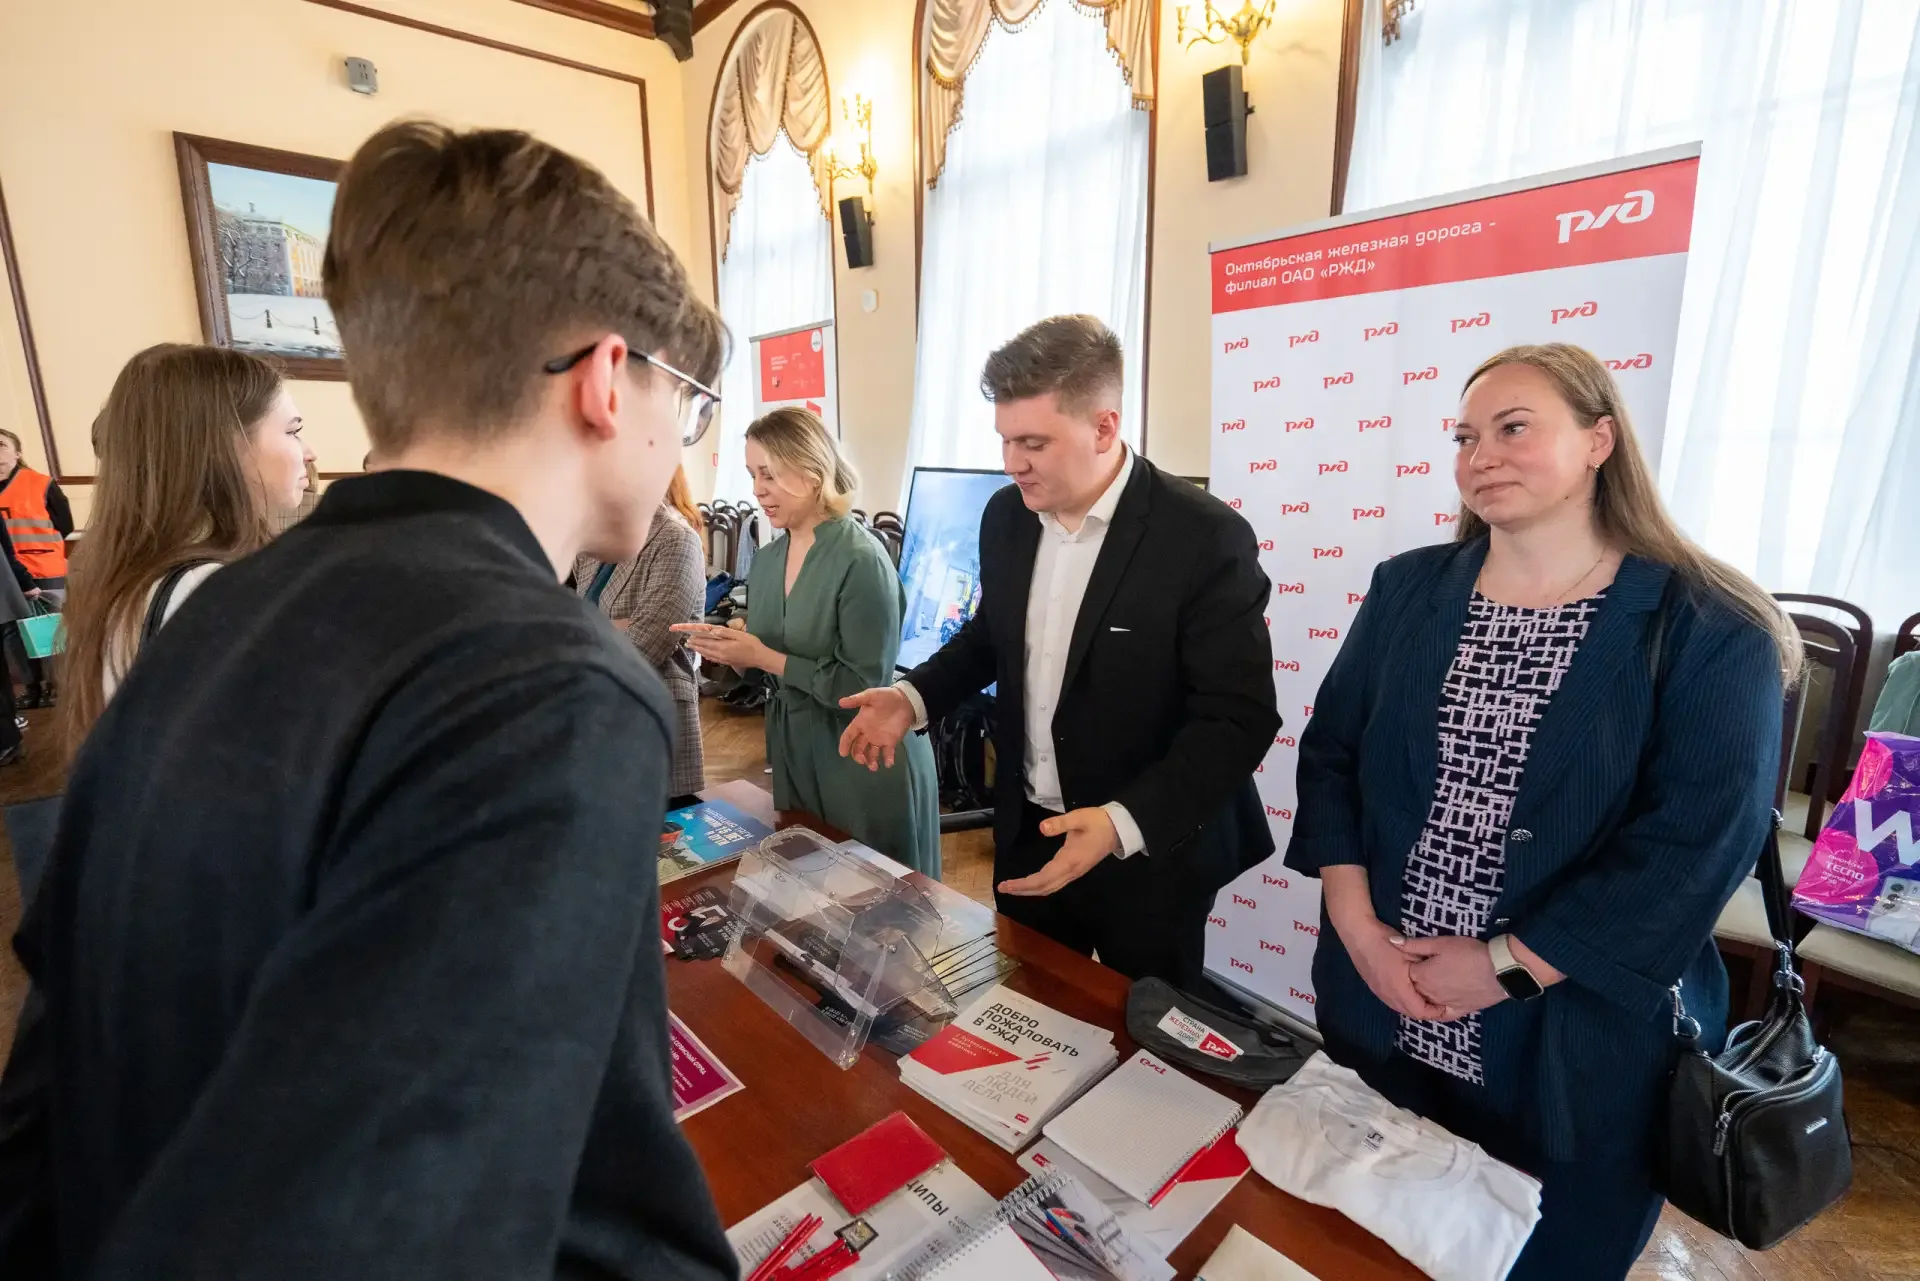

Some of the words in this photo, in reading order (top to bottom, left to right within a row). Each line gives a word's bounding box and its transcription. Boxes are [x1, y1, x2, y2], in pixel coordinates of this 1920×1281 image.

[1225, 250, 1322, 276] Октябрьская
[1328, 234, 1410, 259] железная
[1415, 221, 1482, 246] дорога
[1225, 276, 1276, 295] филиал
[1281, 267, 1315, 285] ОАО
[1320, 259, 1376, 280] «РЖД»
[1825, 861, 1865, 881] TECNO
[990, 1003, 1039, 1028] ДОБРО
[1169, 1015, 1202, 1039] ЖЕЛЕЗНЫХ
[1183, 1016, 1206, 1033] СТРАНА
[973, 1017, 982, 1026] В
[986, 1022, 1019, 1045] РЖД
[982, 1009, 1079, 1057] ПОЖАЛОВАТЬ
[1177, 1030, 1198, 1043] ДОРОГ
[961, 1080, 1002, 1102] ДЕЛА
[984, 1075, 1038, 1106] ЛЮДЕЙ
[996, 1071, 1032, 1089] ДЛЯ
